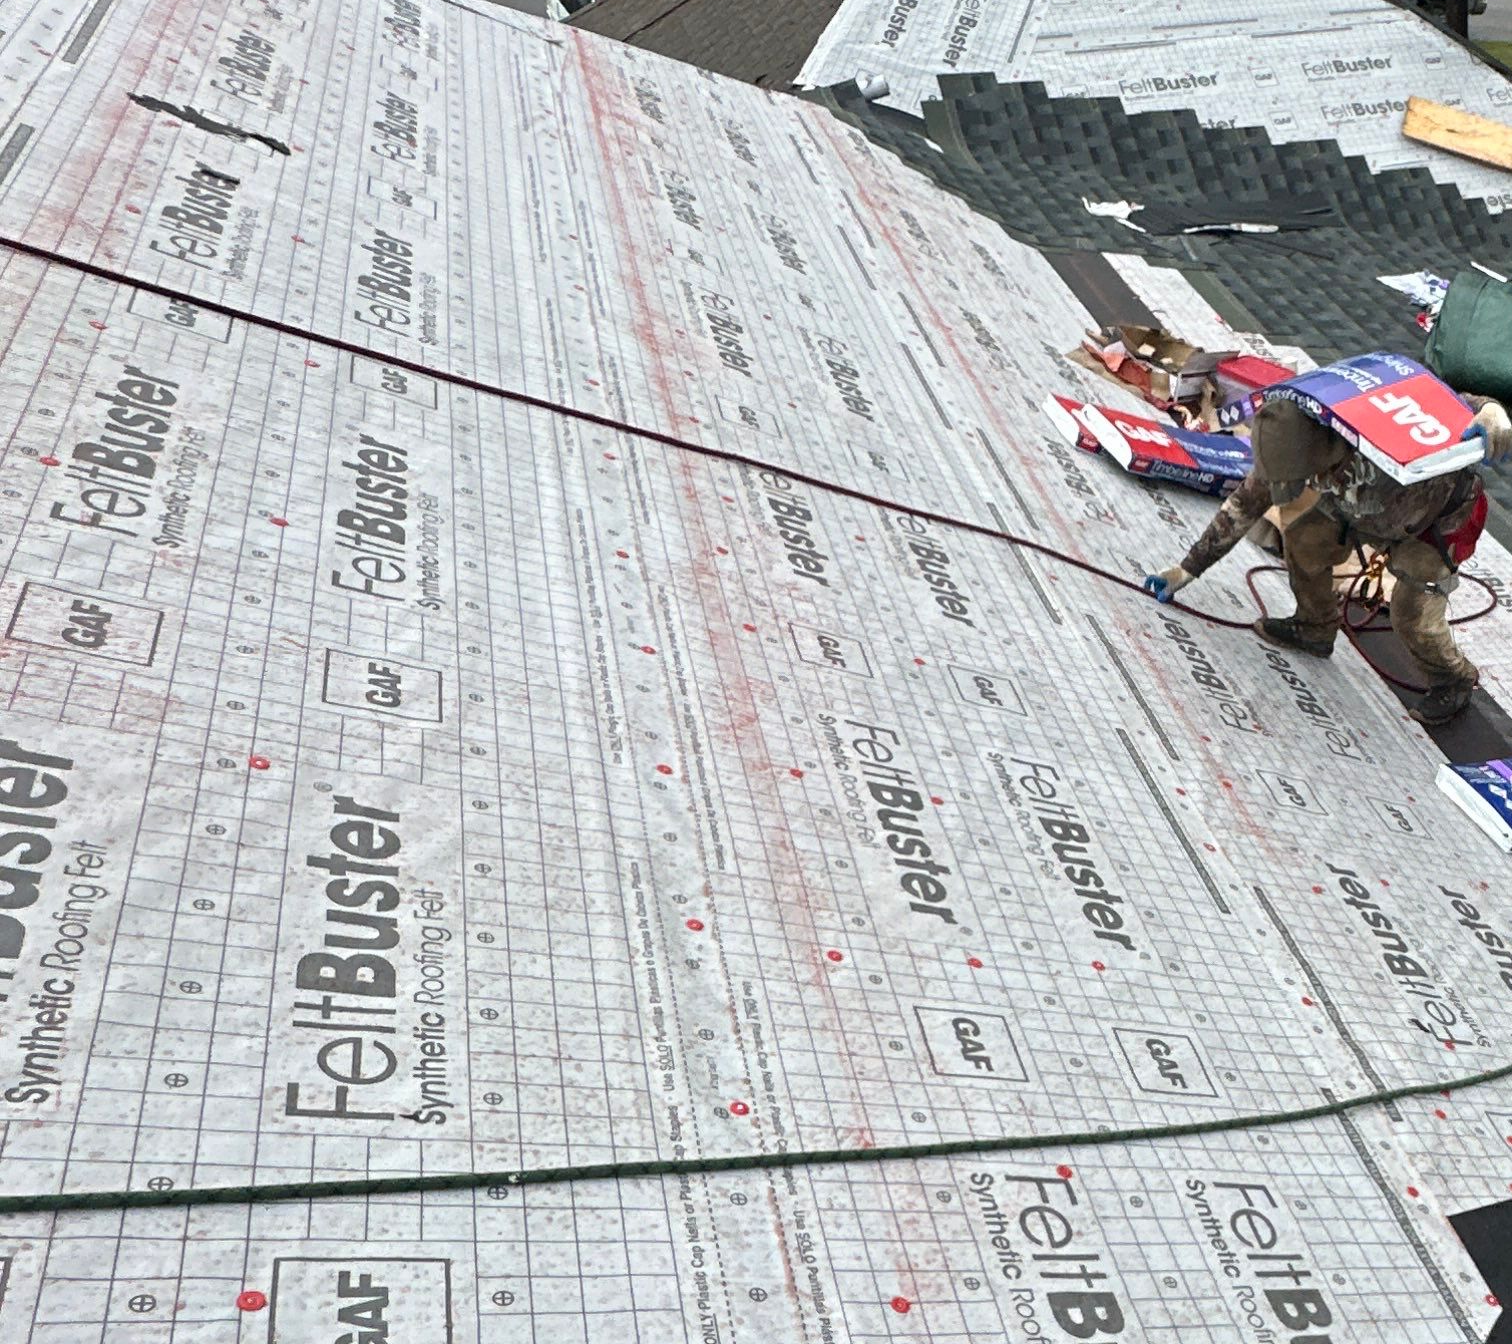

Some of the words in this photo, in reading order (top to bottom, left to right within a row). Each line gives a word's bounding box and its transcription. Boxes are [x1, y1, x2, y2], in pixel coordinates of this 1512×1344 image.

[1119, 73, 1217, 95] FeltBuster
[1301, 56, 1392, 78] FeltBuster
[1321, 98, 1409, 121] FeltBuste
[354, 228, 413, 336] FeltBuster
[381, 367, 408, 394] GAF
[1115, 419, 1170, 447] GAF
[1368, 392, 1450, 445] GAF
[50, 365, 180, 537] FeltBuster
[331, 433, 409, 601] FeltBuster
[760, 469, 830, 587] eltBuster
[60, 599, 114, 650] GAF
[817, 635, 846, 668] GAF
[366, 662, 403, 709] GAF
[973, 676, 1002, 706] GAF
[1156, 613, 1254, 730] FeltBuster
[1258, 643, 1360, 761] FeltBuster
[819, 714, 849, 771] Synthetic
[987, 752, 1022, 806] Synthetic
[846, 718, 958, 925] FeltBuster
[64, 839, 107, 879] Felt
[1011, 757, 1137, 951] FeltBuster
[40, 882, 108, 971] Roofing
[413, 887, 446, 921] Felt
[285, 794, 401, 1120] FeltBuster
[413, 923, 452, 1007] Roofing
[1326, 862, 1473, 1047] FeltBuster
[5, 976, 75, 1106] Synthetic
[412, 1010, 454, 1126] Synthetic
[951, 1016, 994, 1072] GAF
[1144, 1037, 1185, 1092] GAF
[970, 1171, 1023, 1282] Synthetic
[1185, 1178, 1240, 1279] Synthetic
[697, 1267, 711, 1314] Plastic
